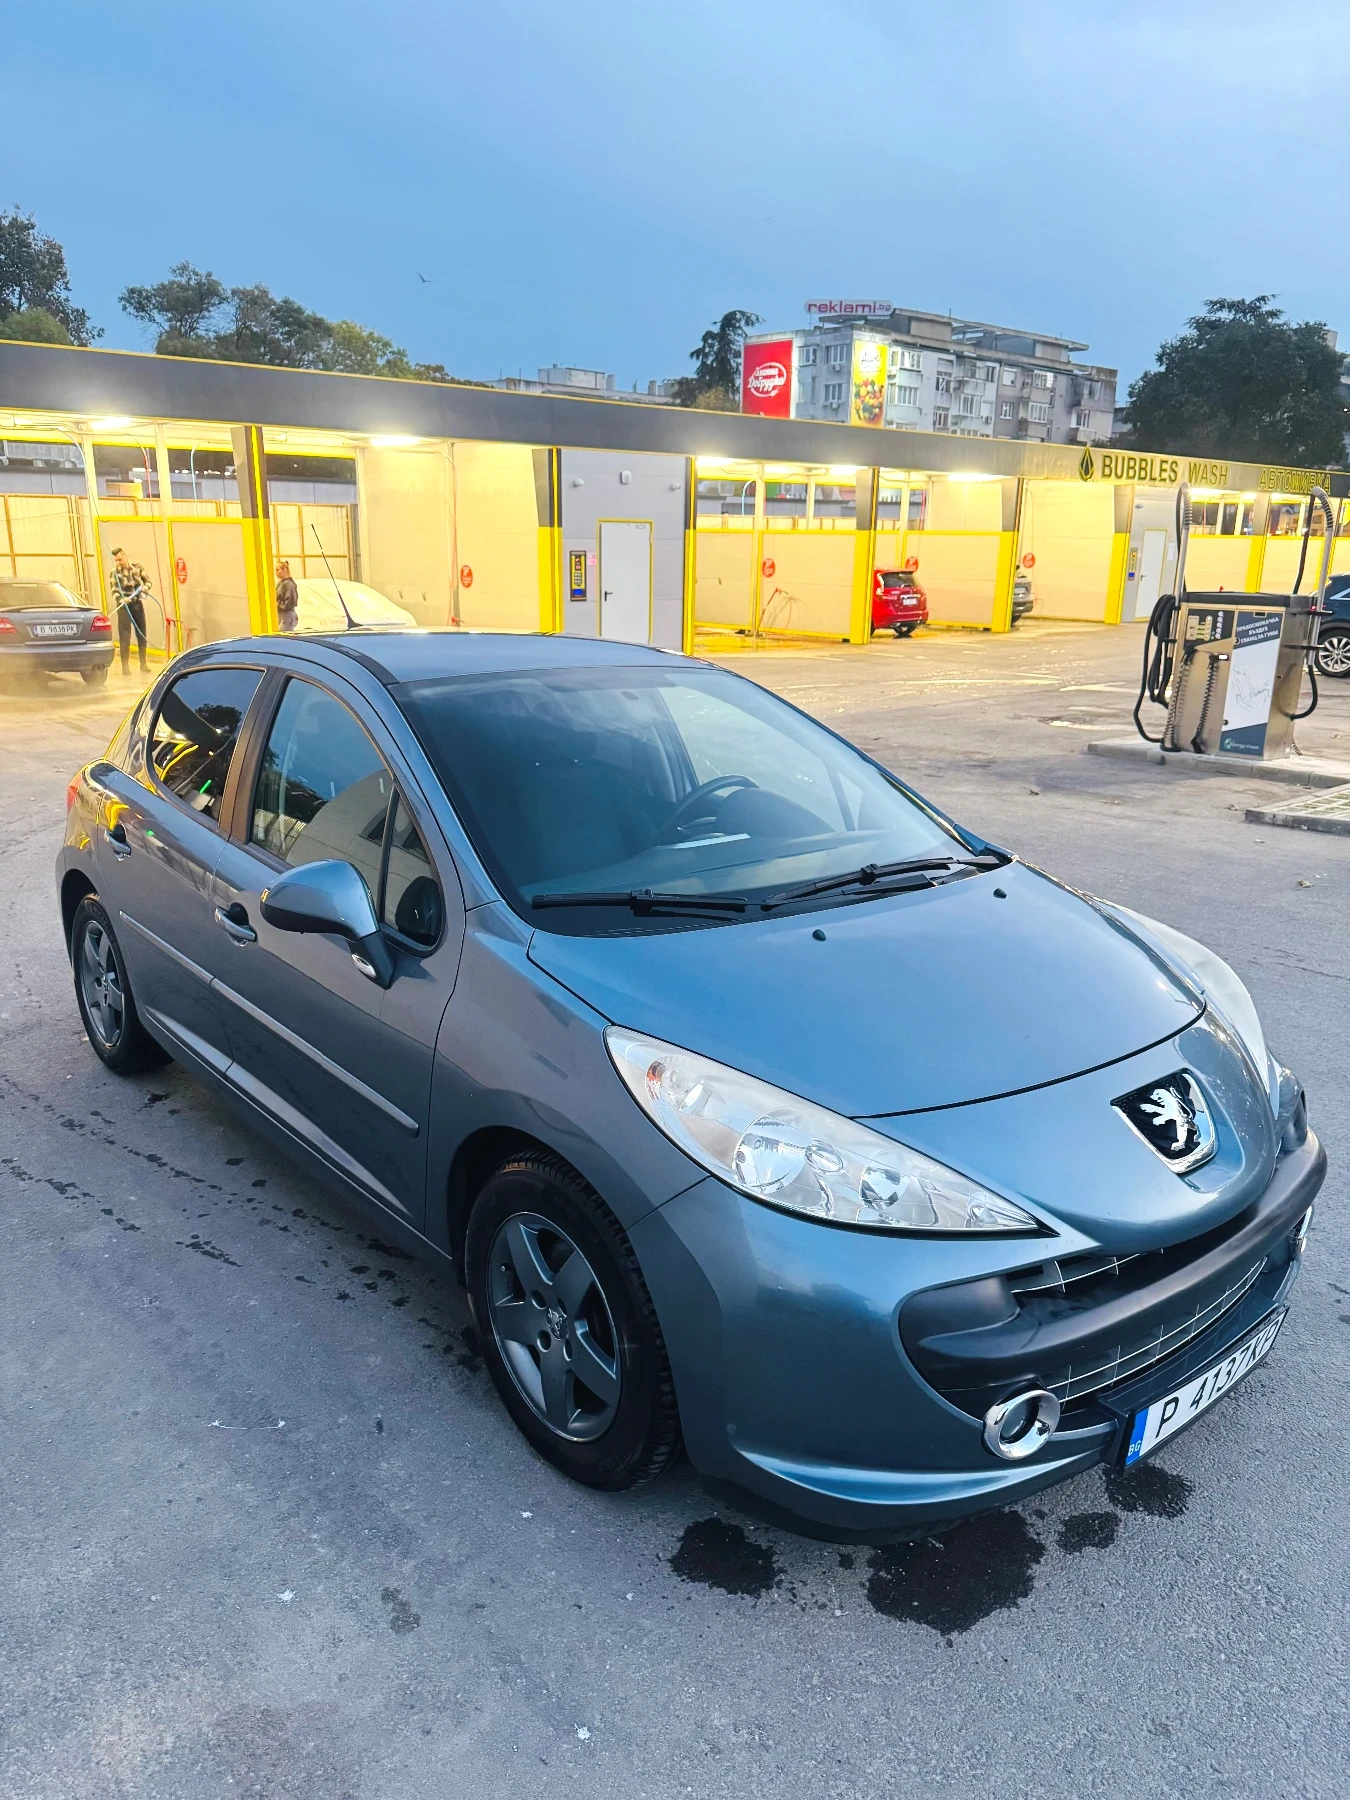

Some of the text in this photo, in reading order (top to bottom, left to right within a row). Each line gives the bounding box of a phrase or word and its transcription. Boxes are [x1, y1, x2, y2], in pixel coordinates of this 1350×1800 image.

[807, 300, 892, 314] reklami.bg
[1102, 453, 1229, 487] BUBBLES WASH
[1127, 1439, 1142, 1457] BG
[1155, 1396, 1180, 1439] P
